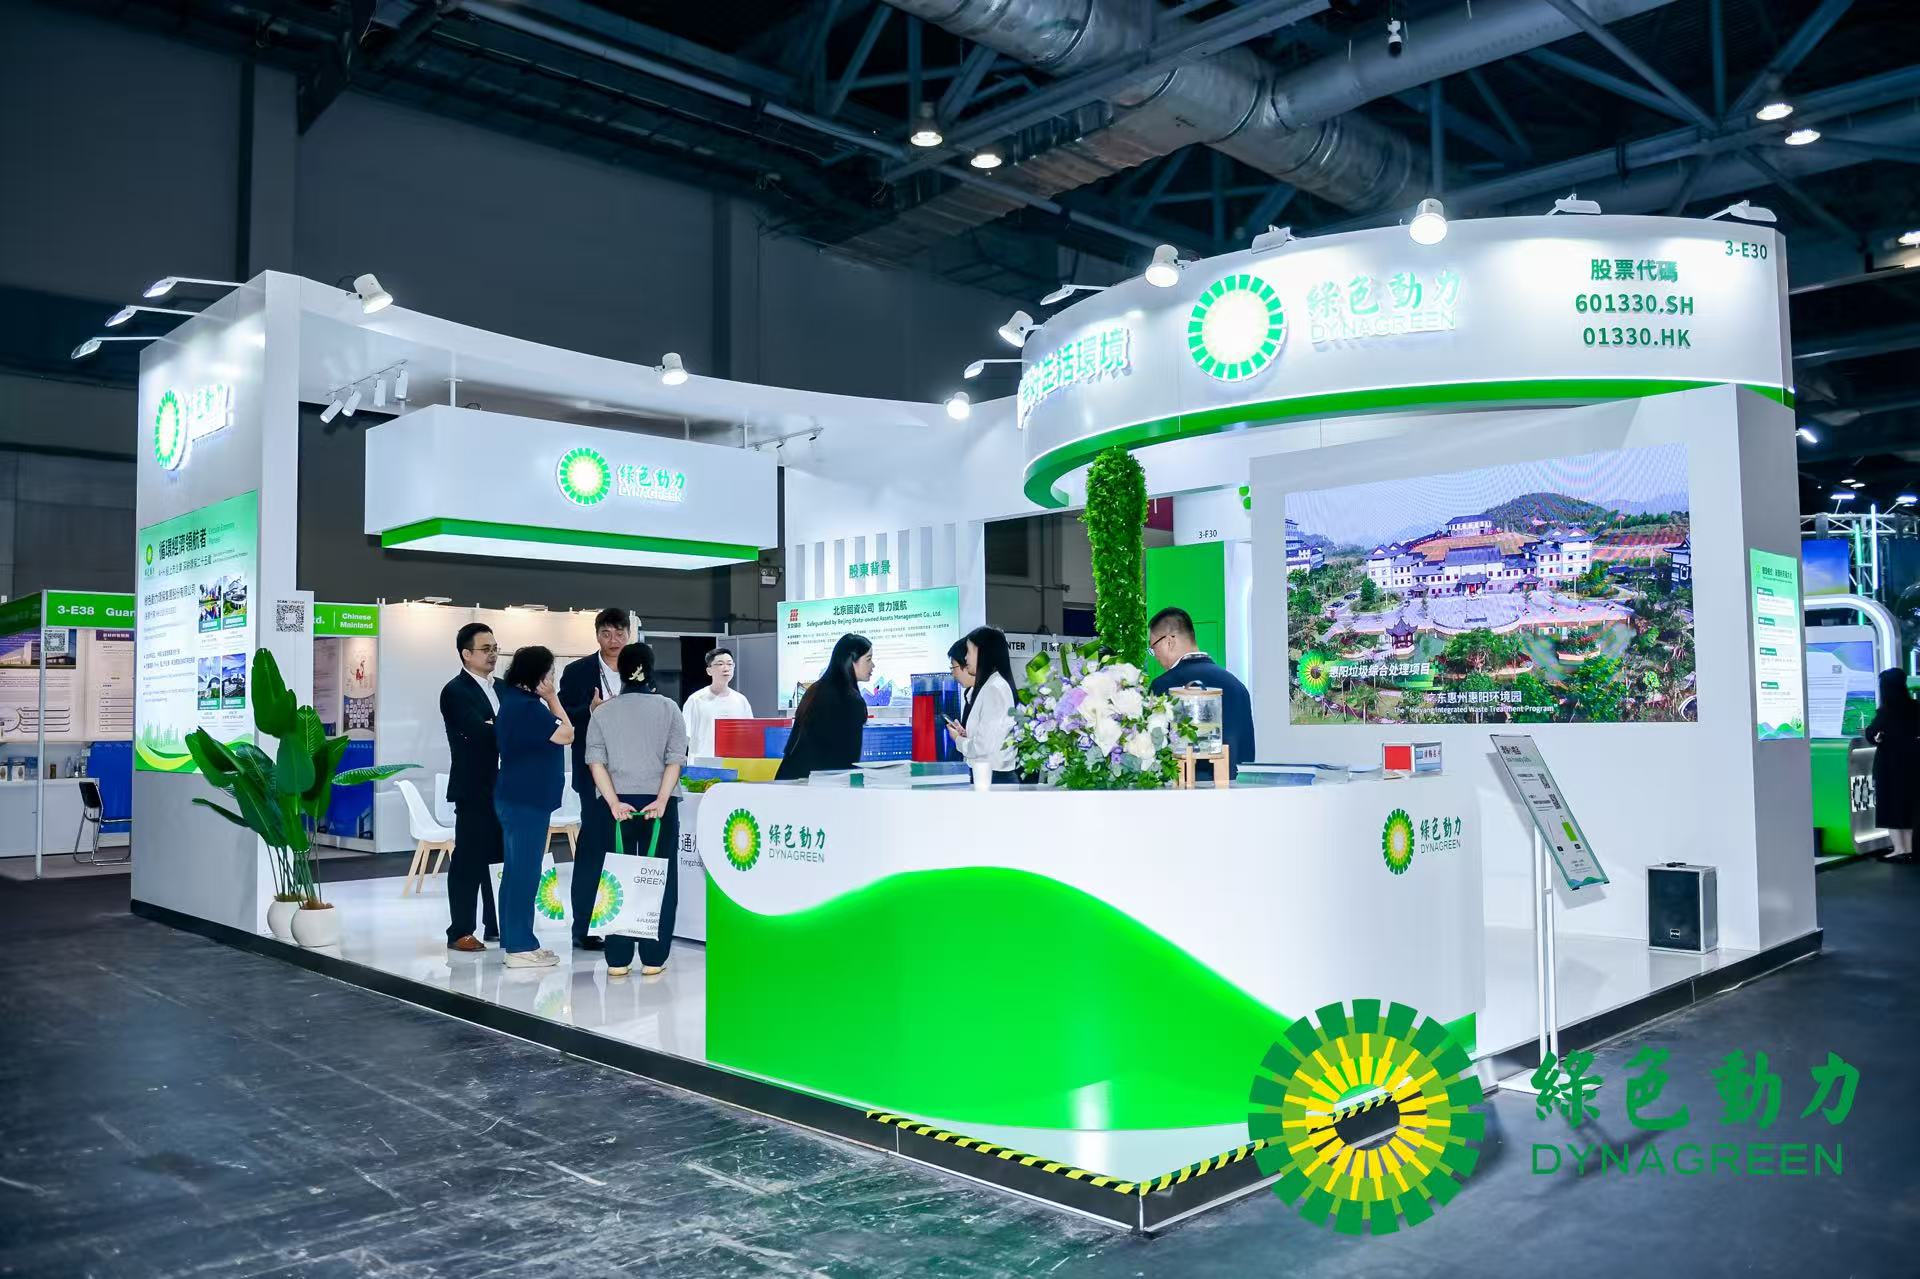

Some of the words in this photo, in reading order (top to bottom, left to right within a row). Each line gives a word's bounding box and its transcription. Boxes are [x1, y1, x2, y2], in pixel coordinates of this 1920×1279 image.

[1725, 240, 1768, 260] 3-E30
[1590, 258, 1679, 282] 股票代碼
[1575, 293, 1694, 316] 601330.SH
[1311, 309, 1457, 343] DYNAGREEN
[1583, 327, 1692, 347] 01330.HK
[849, 560, 891, 578] 股東背景
[57, 605, 95, 615] 3-E38
[340, 621, 374, 629] Mainland
[1329, 662, 1431, 677] 惠阳垃圾综合处理项目
[1427, 691, 1522, 703] 广东惠州惠阳环境园
[1436, 706, 1468, 714] Integrated
[1489, 705, 1524, 713] Treatment
[1420, 815, 1462, 841] 綠色動力
[768, 824, 826, 849] 綠色動力
[1420, 838, 1462, 854] DYNAGREEN
[769, 848, 825, 863] DYNAGREEN
[640, 867, 666, 877] DYNA
[633, 876, 666, 886] GREEN
